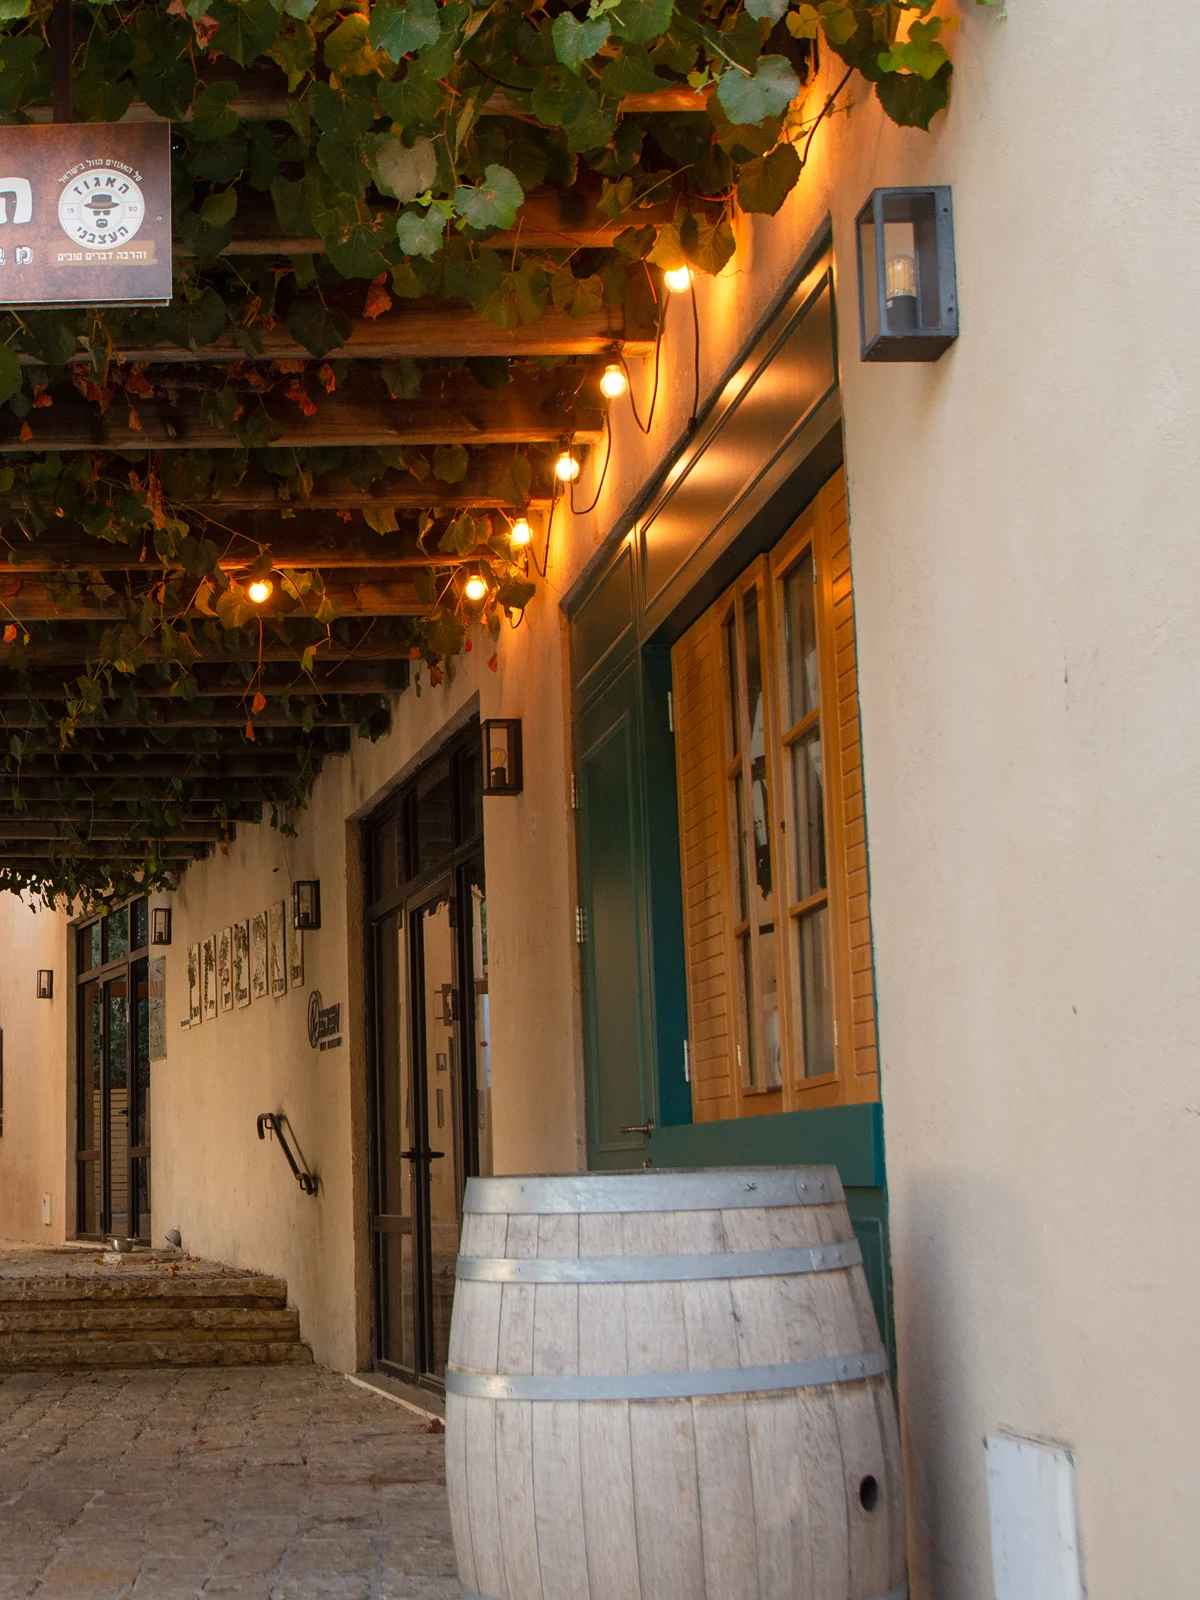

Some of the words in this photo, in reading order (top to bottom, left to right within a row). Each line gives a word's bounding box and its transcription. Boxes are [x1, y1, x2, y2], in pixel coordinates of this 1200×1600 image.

[85, 159, 103, 167] הזול
[105, 159, 133, 174] האגוזים
[57, 163, 86, 184] בישראל
[73, 176, 130, 196] האגוז
[76, 225, 129, 245] העצבני
[57, 252, 83, 262] טובים
[85, 251, 114, 261] דברים
[116, 251, 147, 260] והרבה
